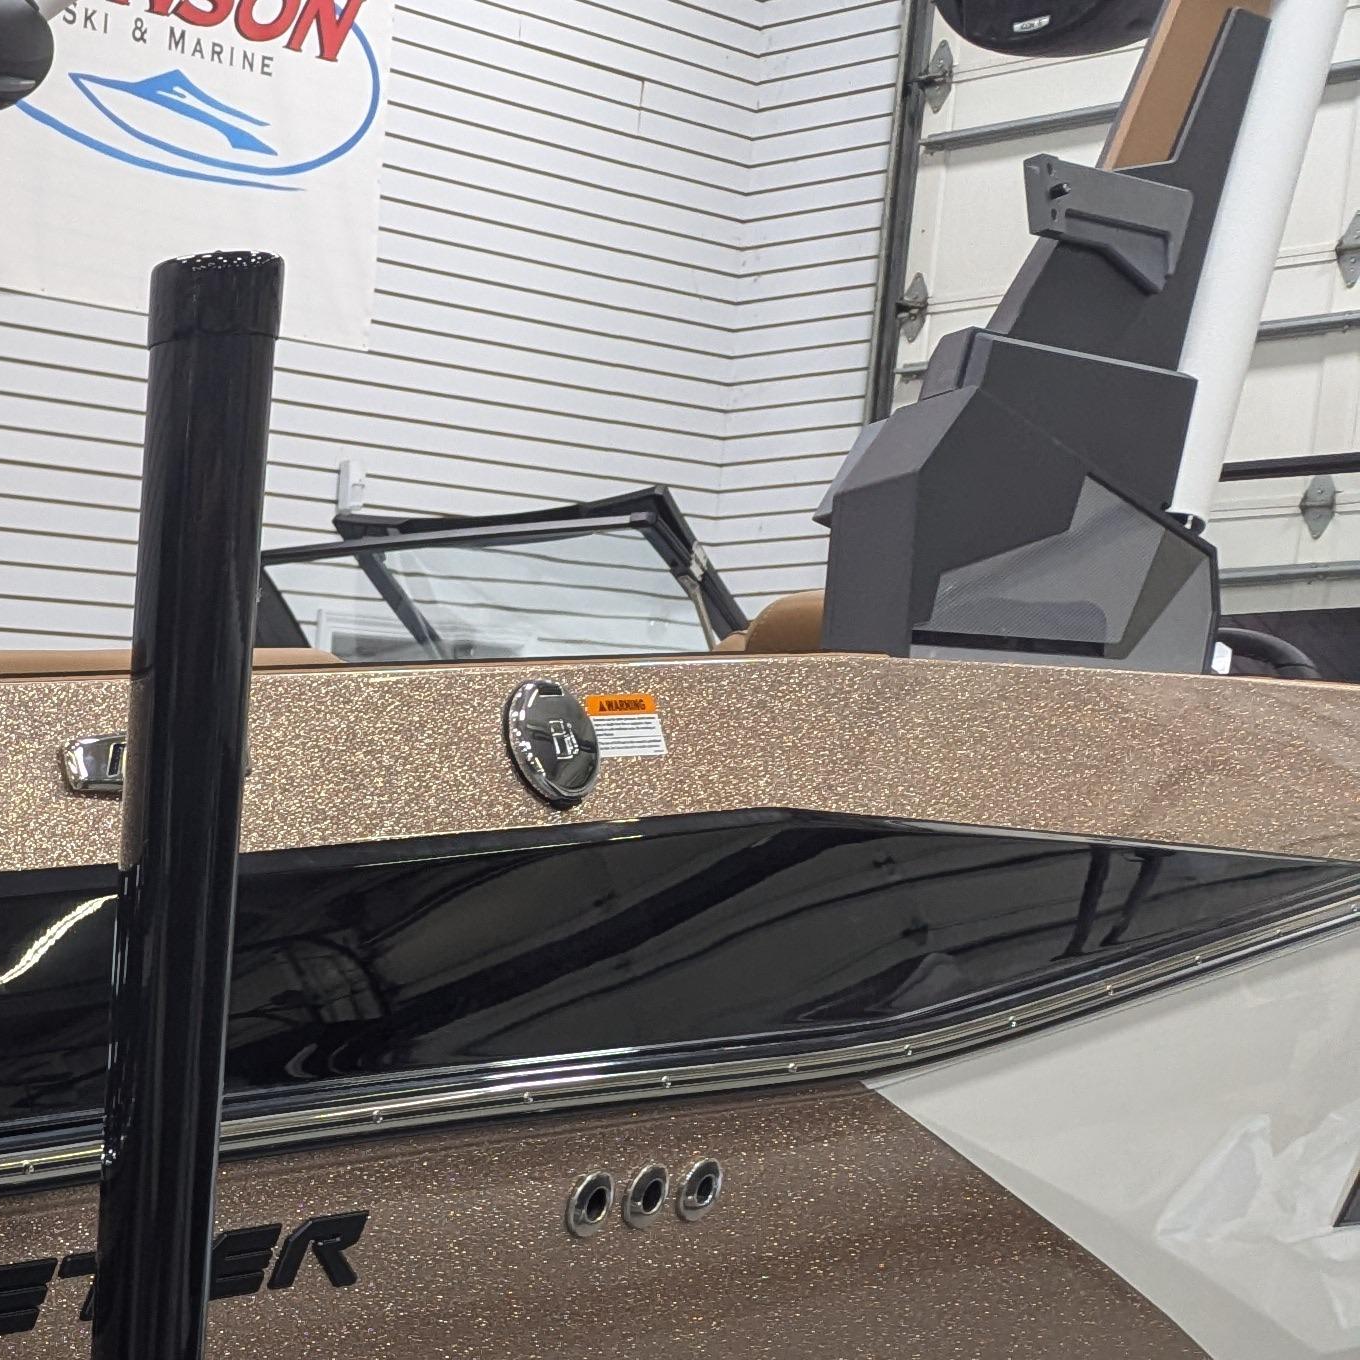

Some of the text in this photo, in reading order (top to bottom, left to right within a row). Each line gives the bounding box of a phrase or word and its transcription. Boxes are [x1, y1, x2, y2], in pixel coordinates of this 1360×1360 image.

[62, 5, 274, 77] SKI & MARINE
[606, 699, 646, 711] WARNING
